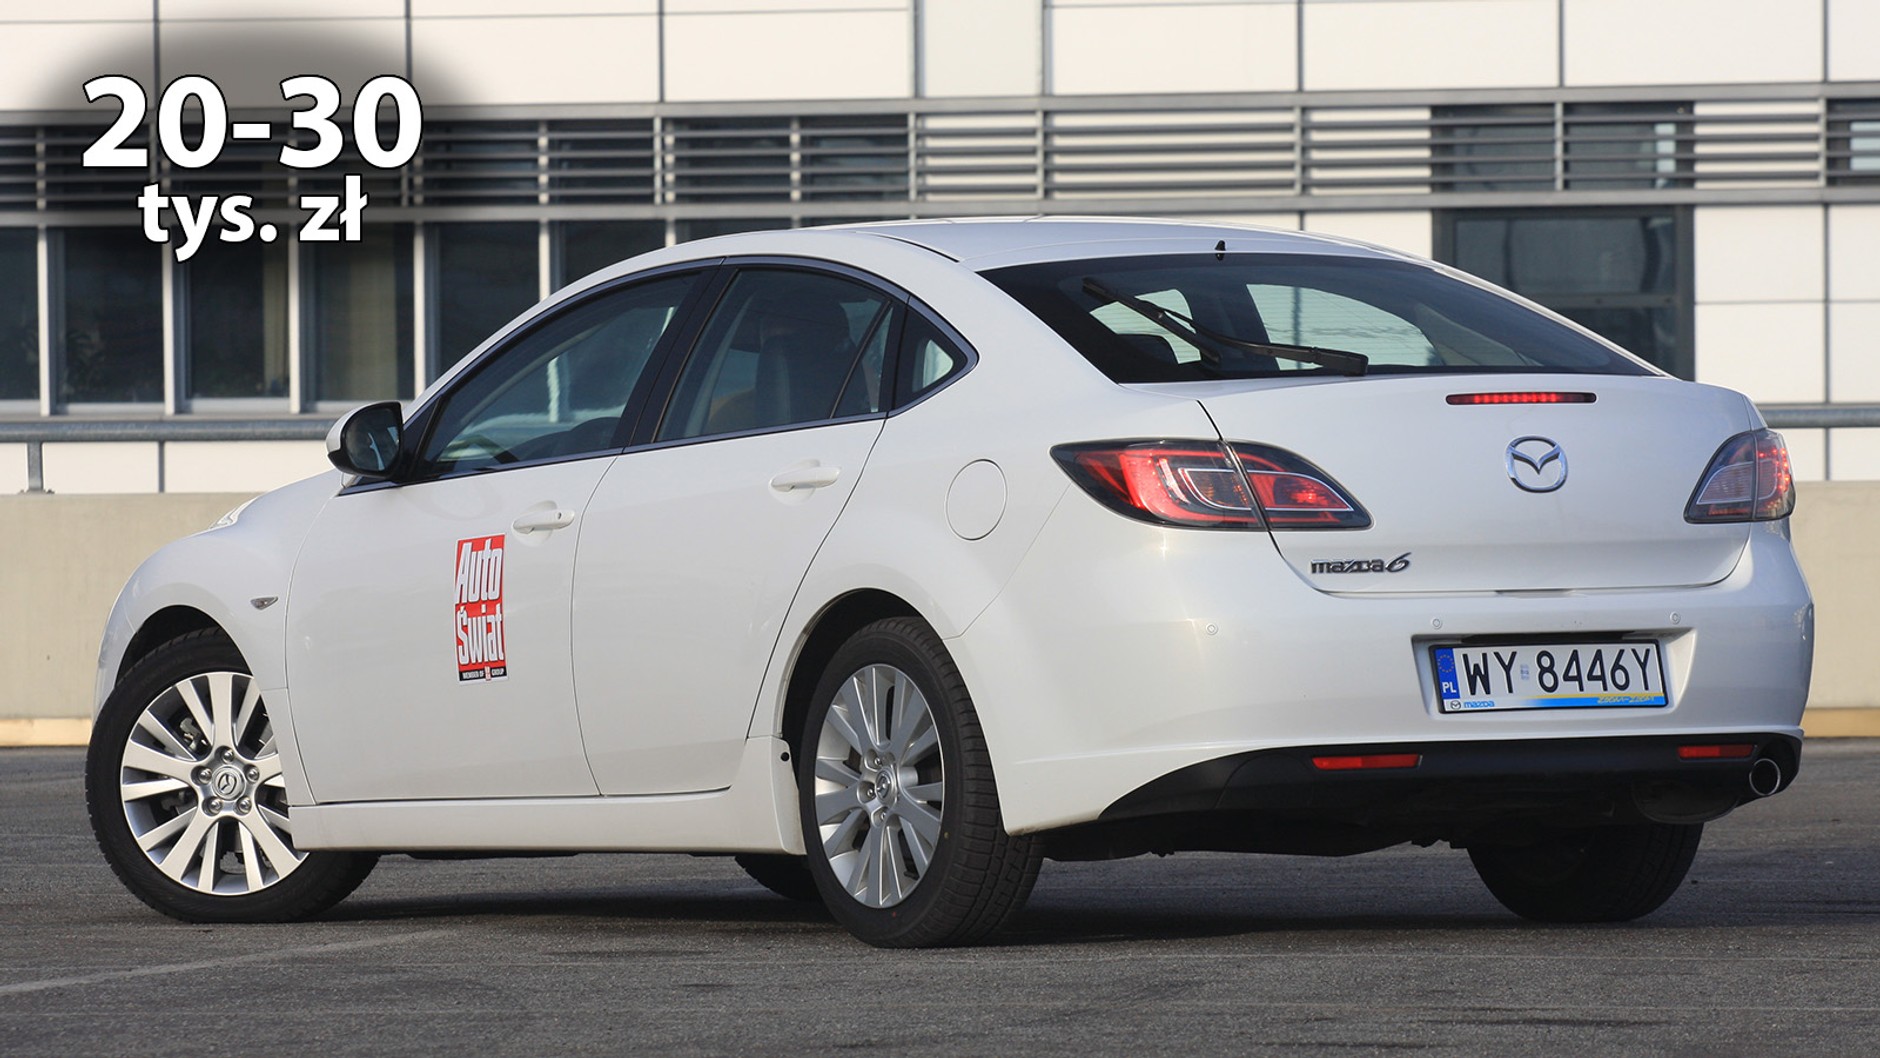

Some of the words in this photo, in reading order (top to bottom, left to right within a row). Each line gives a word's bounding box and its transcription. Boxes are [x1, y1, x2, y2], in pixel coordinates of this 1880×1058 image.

[454, 538, 503, 604] Auto
[457, 603, 505, 665] Świat
[1442, 681, 1457, 693] PL
[1462, 651, 1517, 695] WY
[1536, 648, 1651, 693] 8446Y
